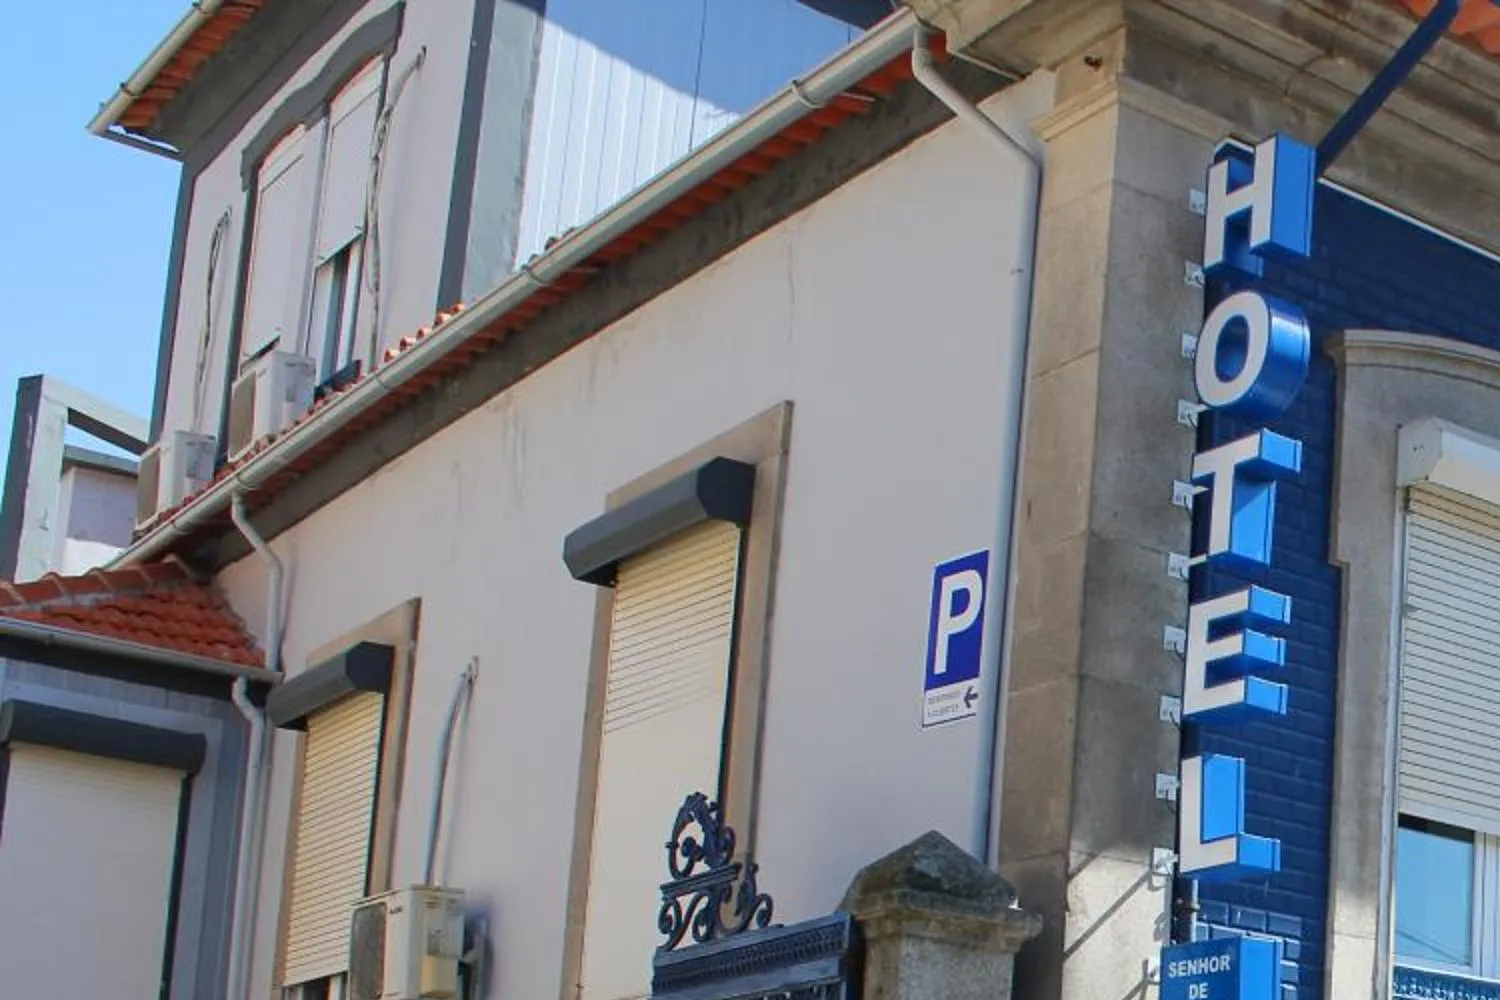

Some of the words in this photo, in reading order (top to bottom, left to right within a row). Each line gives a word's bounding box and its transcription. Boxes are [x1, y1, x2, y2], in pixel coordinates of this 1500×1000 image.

[1179, 134, 1278, 875] HOTEL
[933, 569, 983, 675] P
[1168, 954, 1231, 979] SENHOR
[1188, 982, 1209, 1000] DE
